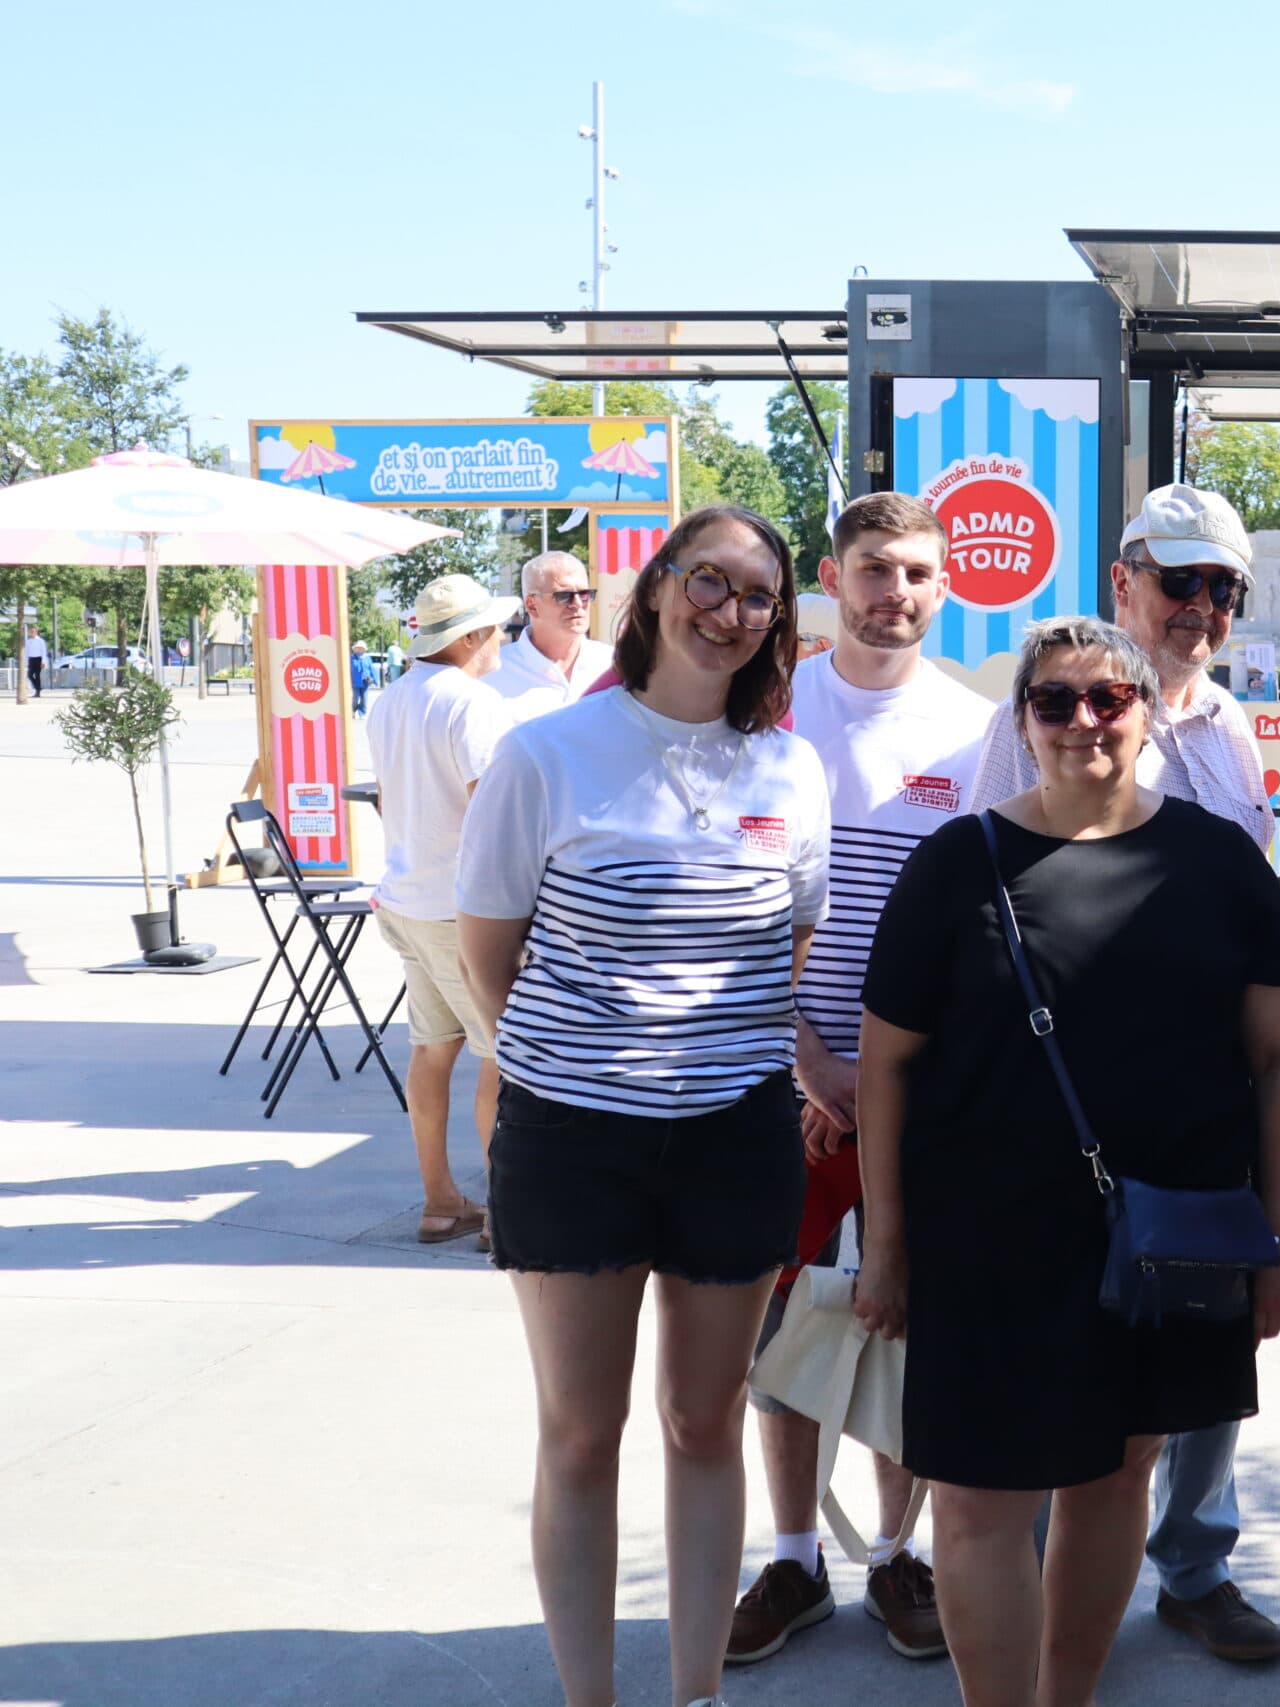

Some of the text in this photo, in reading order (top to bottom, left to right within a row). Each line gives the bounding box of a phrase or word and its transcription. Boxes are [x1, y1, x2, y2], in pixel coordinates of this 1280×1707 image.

[383, 442, 544, 472] et si on parlait fin
[374, 463, 555, 491] de vie... autrement ?
[929, 466, 968, 498] tournée
[970, 461, 986, 475] fin
[989, 460, 1003, 473] de
[1006, 464, 1022, 478] vie
[952, 512, 1035, 538] ADMD
[951, 548, 1032, 575] TOUR
[291, 667, 322, 678] ADMD
[291, 682, 322, 691] TOUR
[1260, 720, 1276, 736] La
